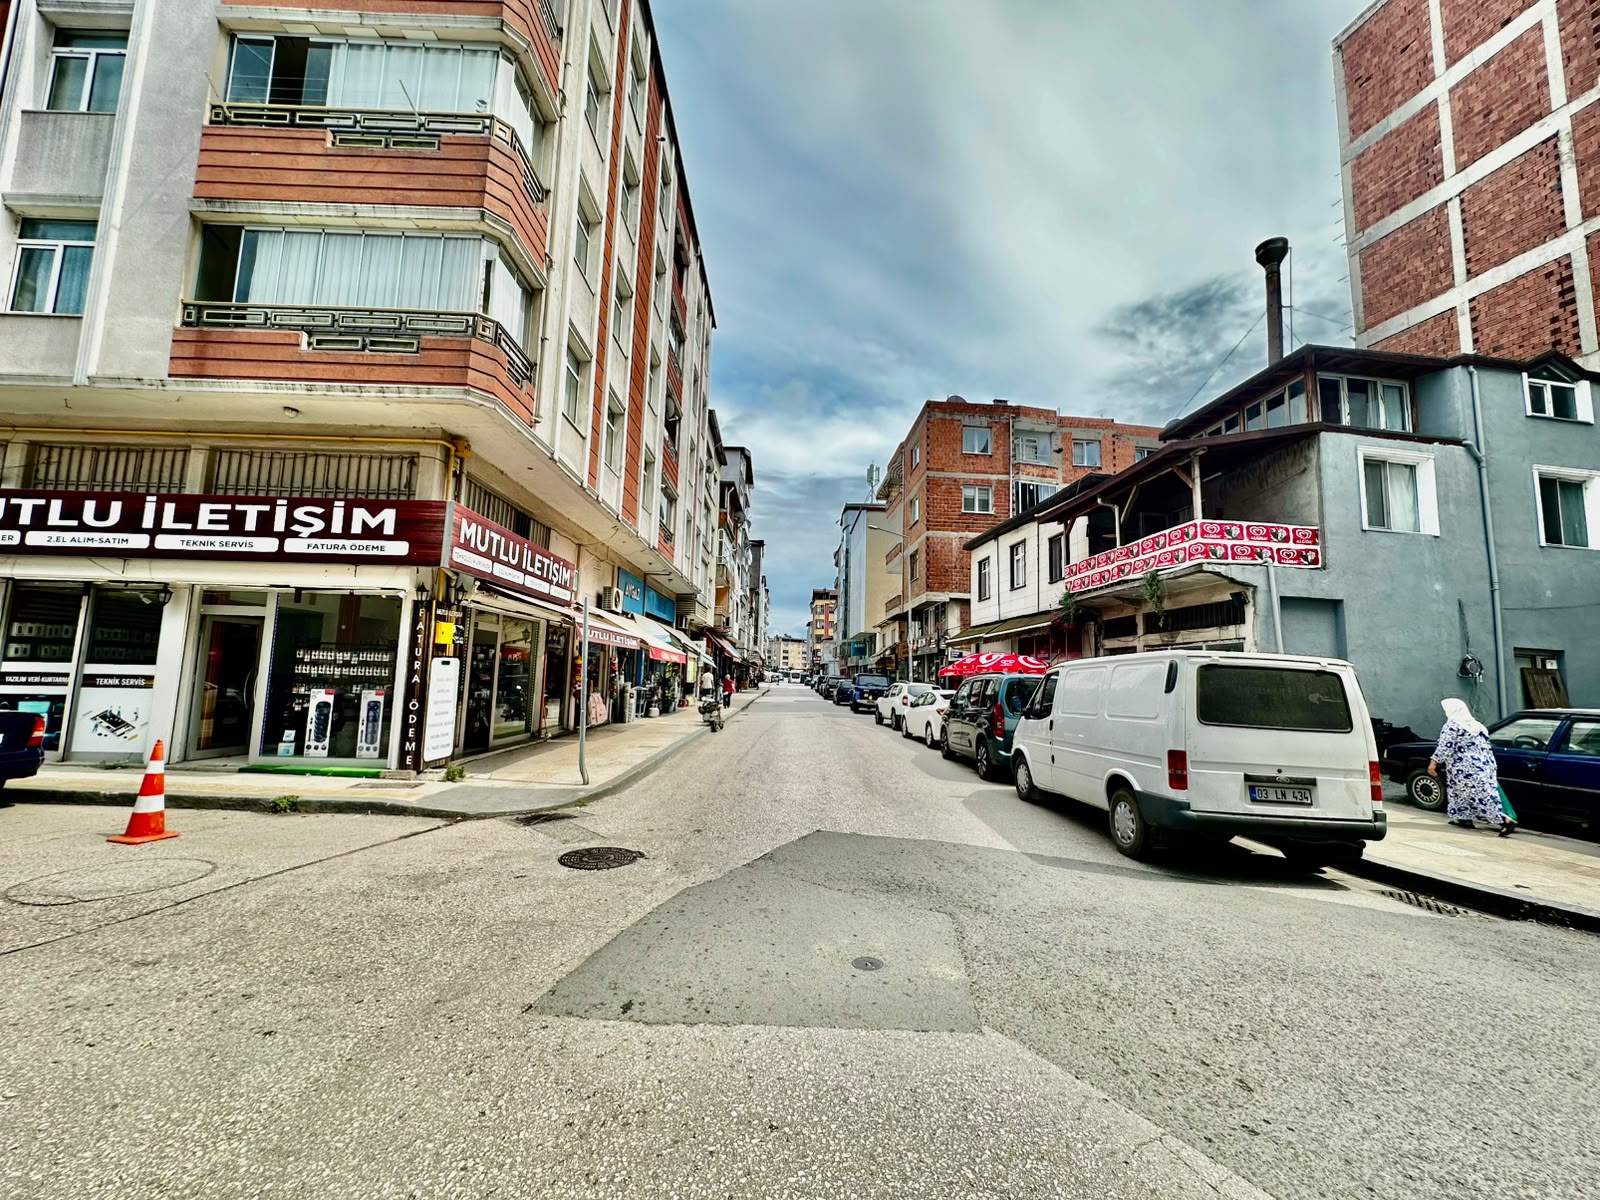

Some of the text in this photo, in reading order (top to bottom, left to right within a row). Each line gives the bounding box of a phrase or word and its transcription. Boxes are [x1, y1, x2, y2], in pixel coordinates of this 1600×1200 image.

[0, 495, 397, 538] TLU İLETİŞİM
[69, 537, 129, 545] ALIM-SATIM
[180, 539, 254, 548] TEKNİK SERVİS
[306, 543, 386, 552] FATURA ÖDEME
[459, 517, 520, 565] MUTLU
[521, 542, 571, 588] İLETİŞİM
[411, 608, 425, 683] FATURA
[96, 676, 145, 686] TEKNİK SERVİS
[405, 698, 419, 765] ÖDEME
[1257, 788, 1309, 802] 03 LN 434
